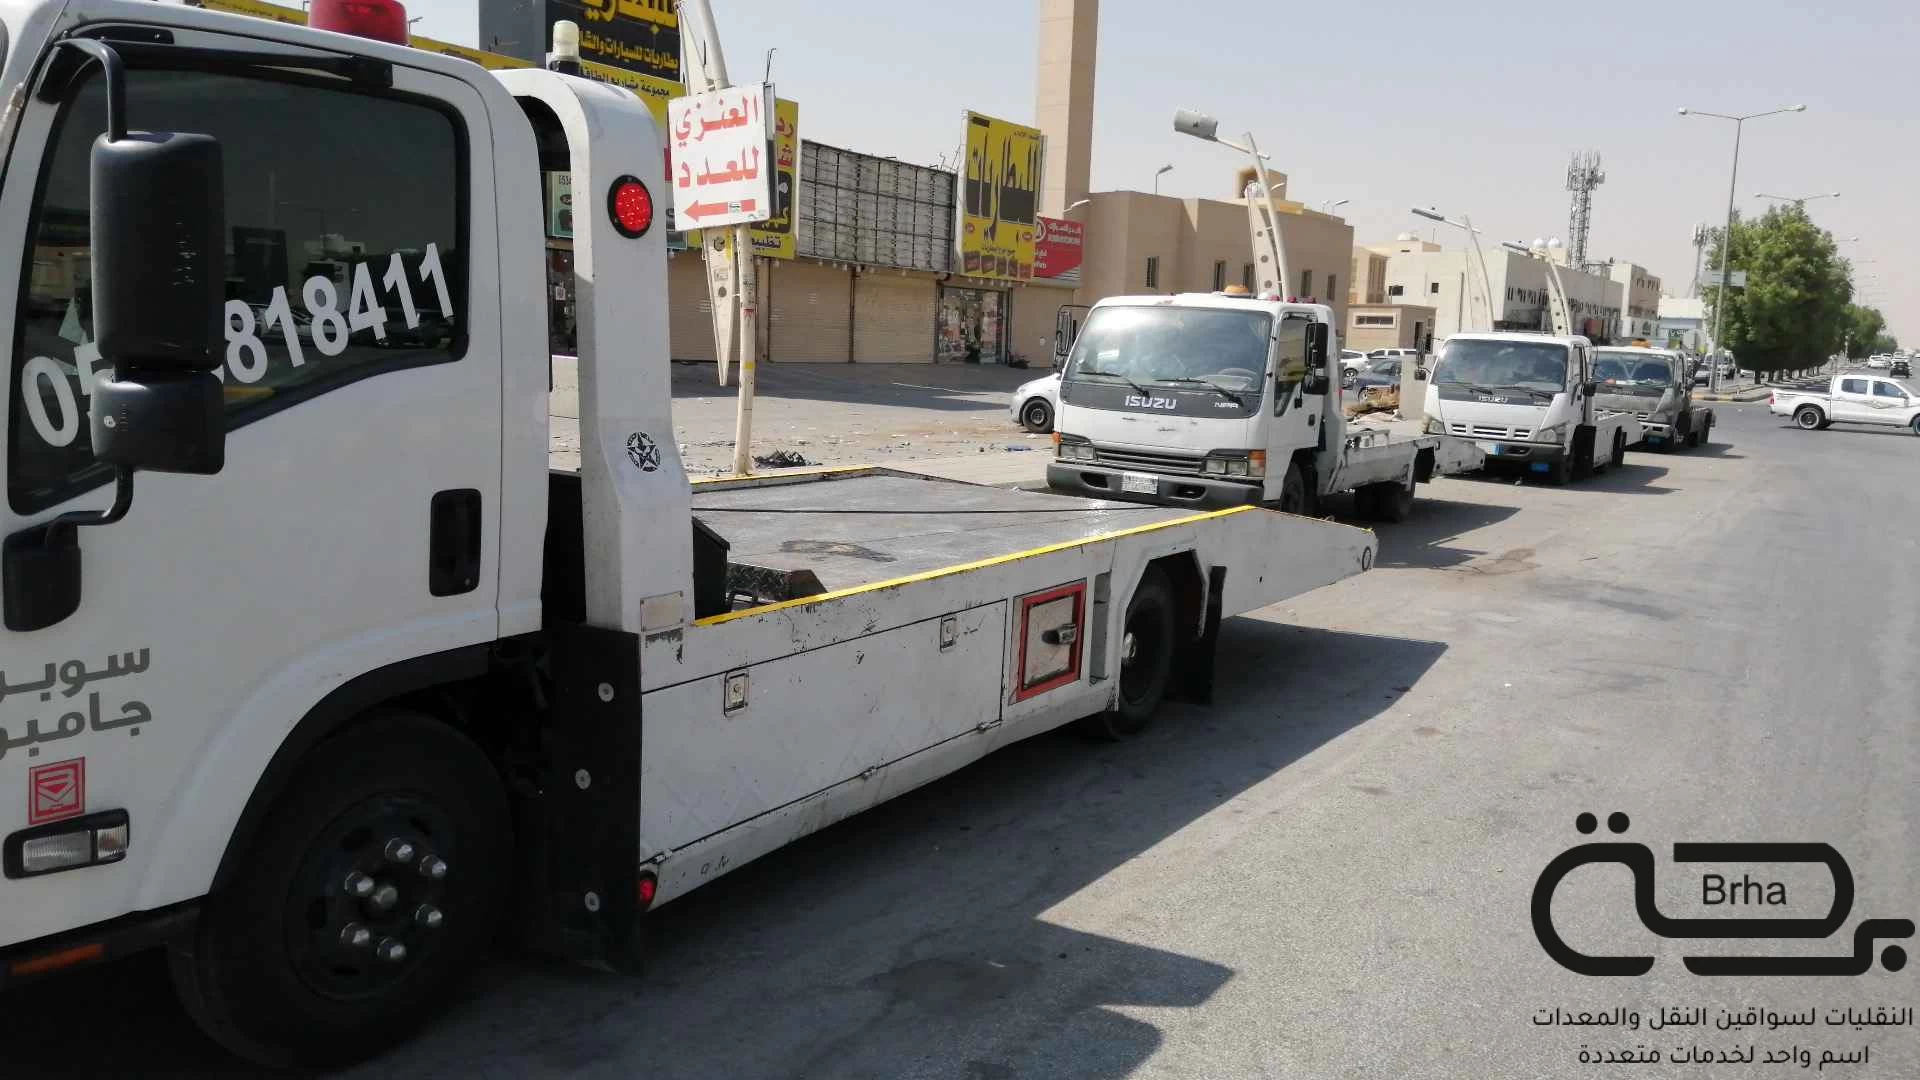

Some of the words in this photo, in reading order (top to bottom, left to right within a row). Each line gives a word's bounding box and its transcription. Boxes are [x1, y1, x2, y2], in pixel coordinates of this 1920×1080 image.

[675, 95, 759, 148] العنزي
[678, 145, 760, 188] للعدد
[1125, 395, 1177, 410] ISUZU
